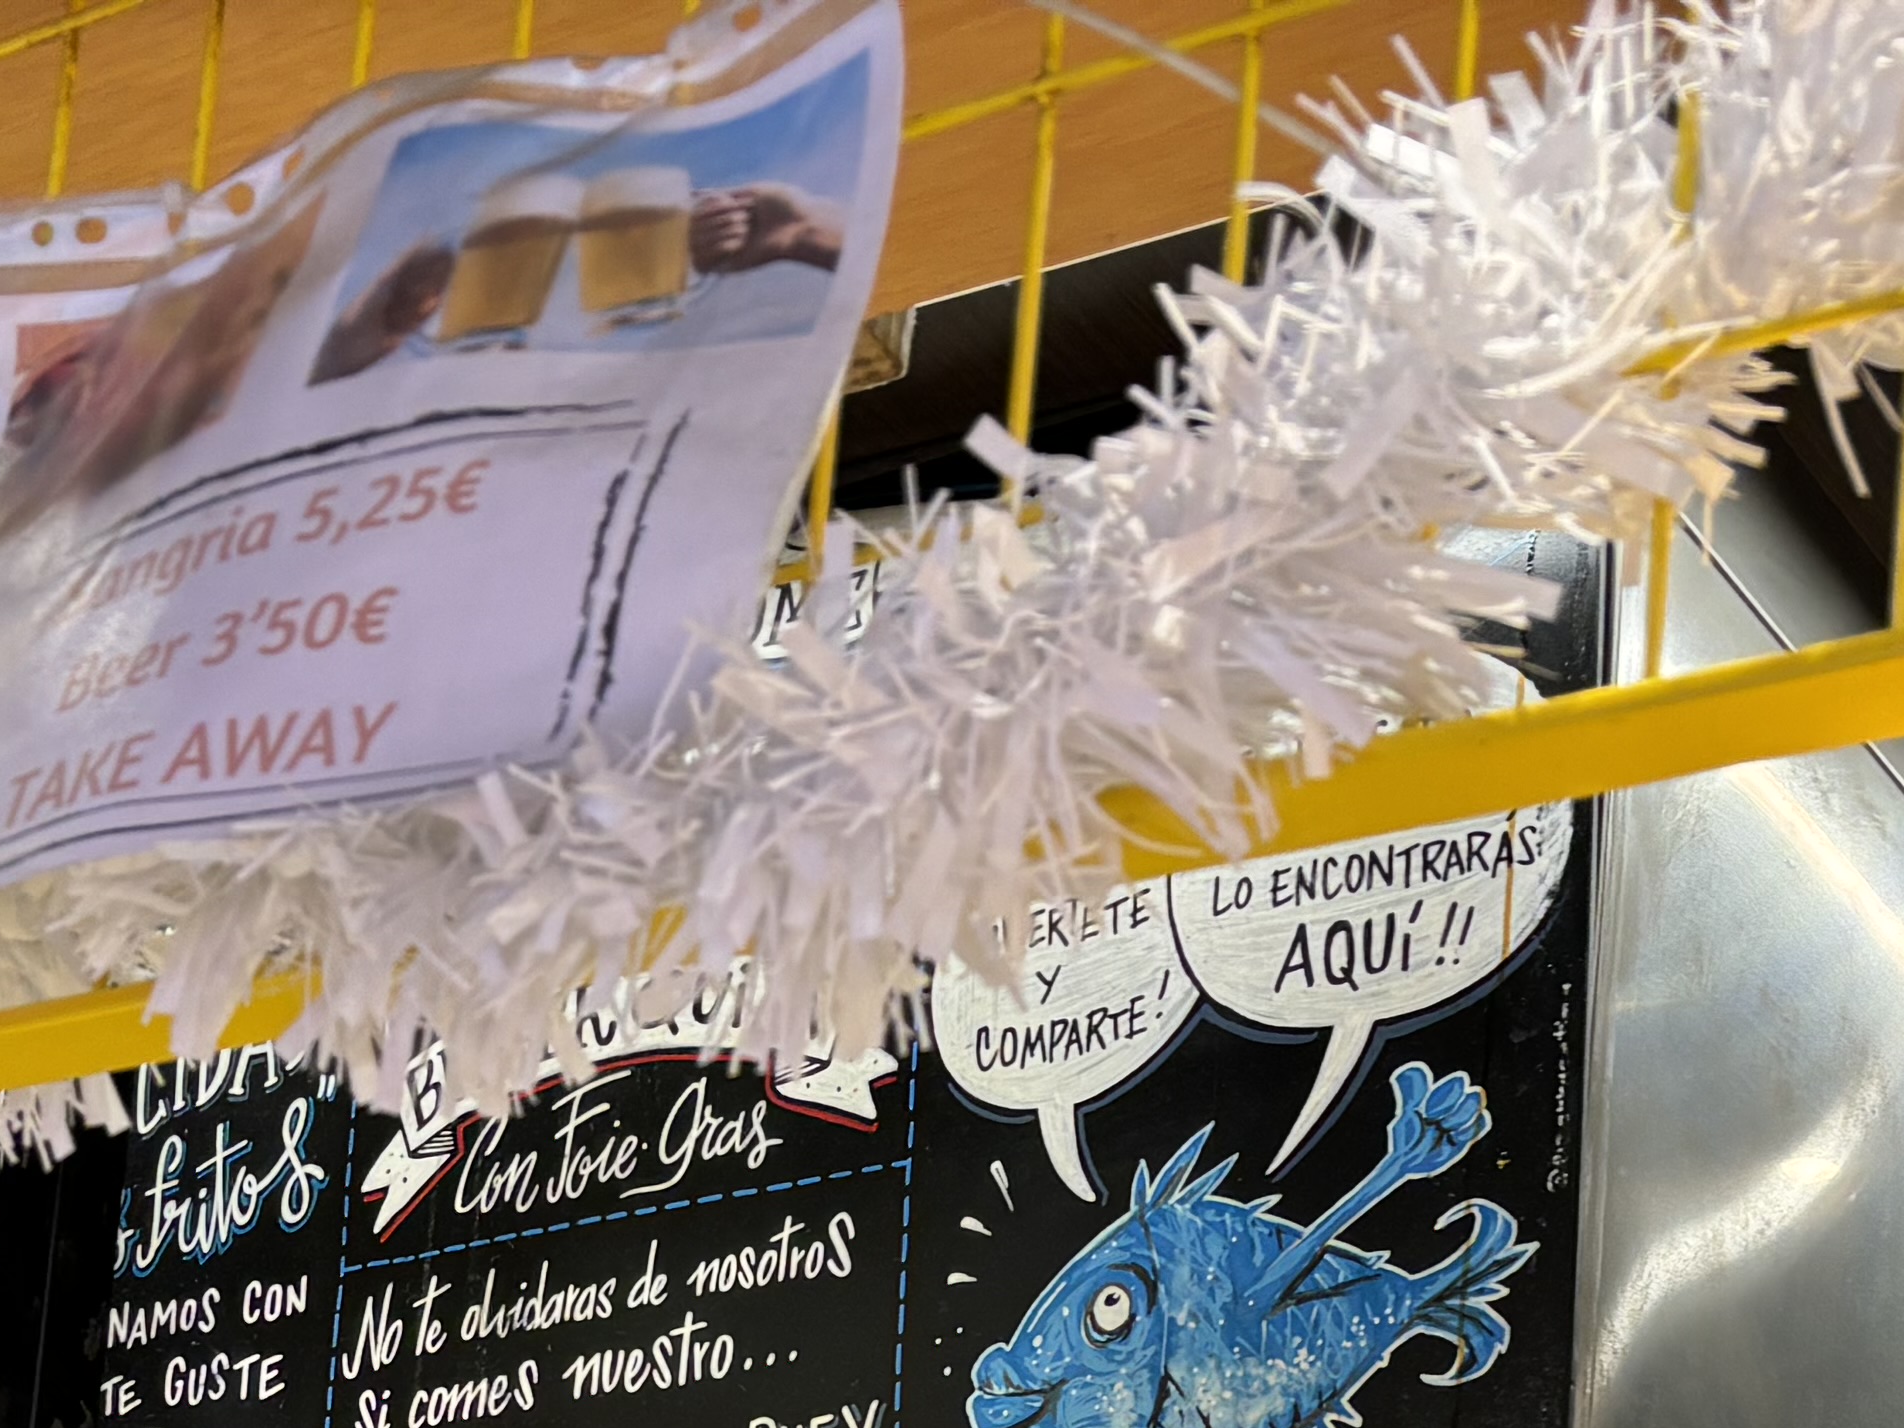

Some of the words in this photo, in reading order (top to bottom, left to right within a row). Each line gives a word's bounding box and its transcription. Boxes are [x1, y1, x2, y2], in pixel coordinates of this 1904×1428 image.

[296, 458, 491, 545] 5,25€
[5, 731, 156, 829] TAKE
[160, 700, 399, 786] AWAY
[1211, 874, 1253, 918] LO
[975, 968, 1171, 1073] COMPARTE!
[1035, 964, 1063, 1005] Y
[453, 1114, 540, 1215] Con
[242, 1274, 310, 1322] CON
[341, 1298, 404, 1381] No
[411, 1264, 448, 1357] te
[461, 1262, 617, 1343] olvidaras
[627, 1239, 668, 1308] de
[163, 1352, 288, 1408] GUSTE
